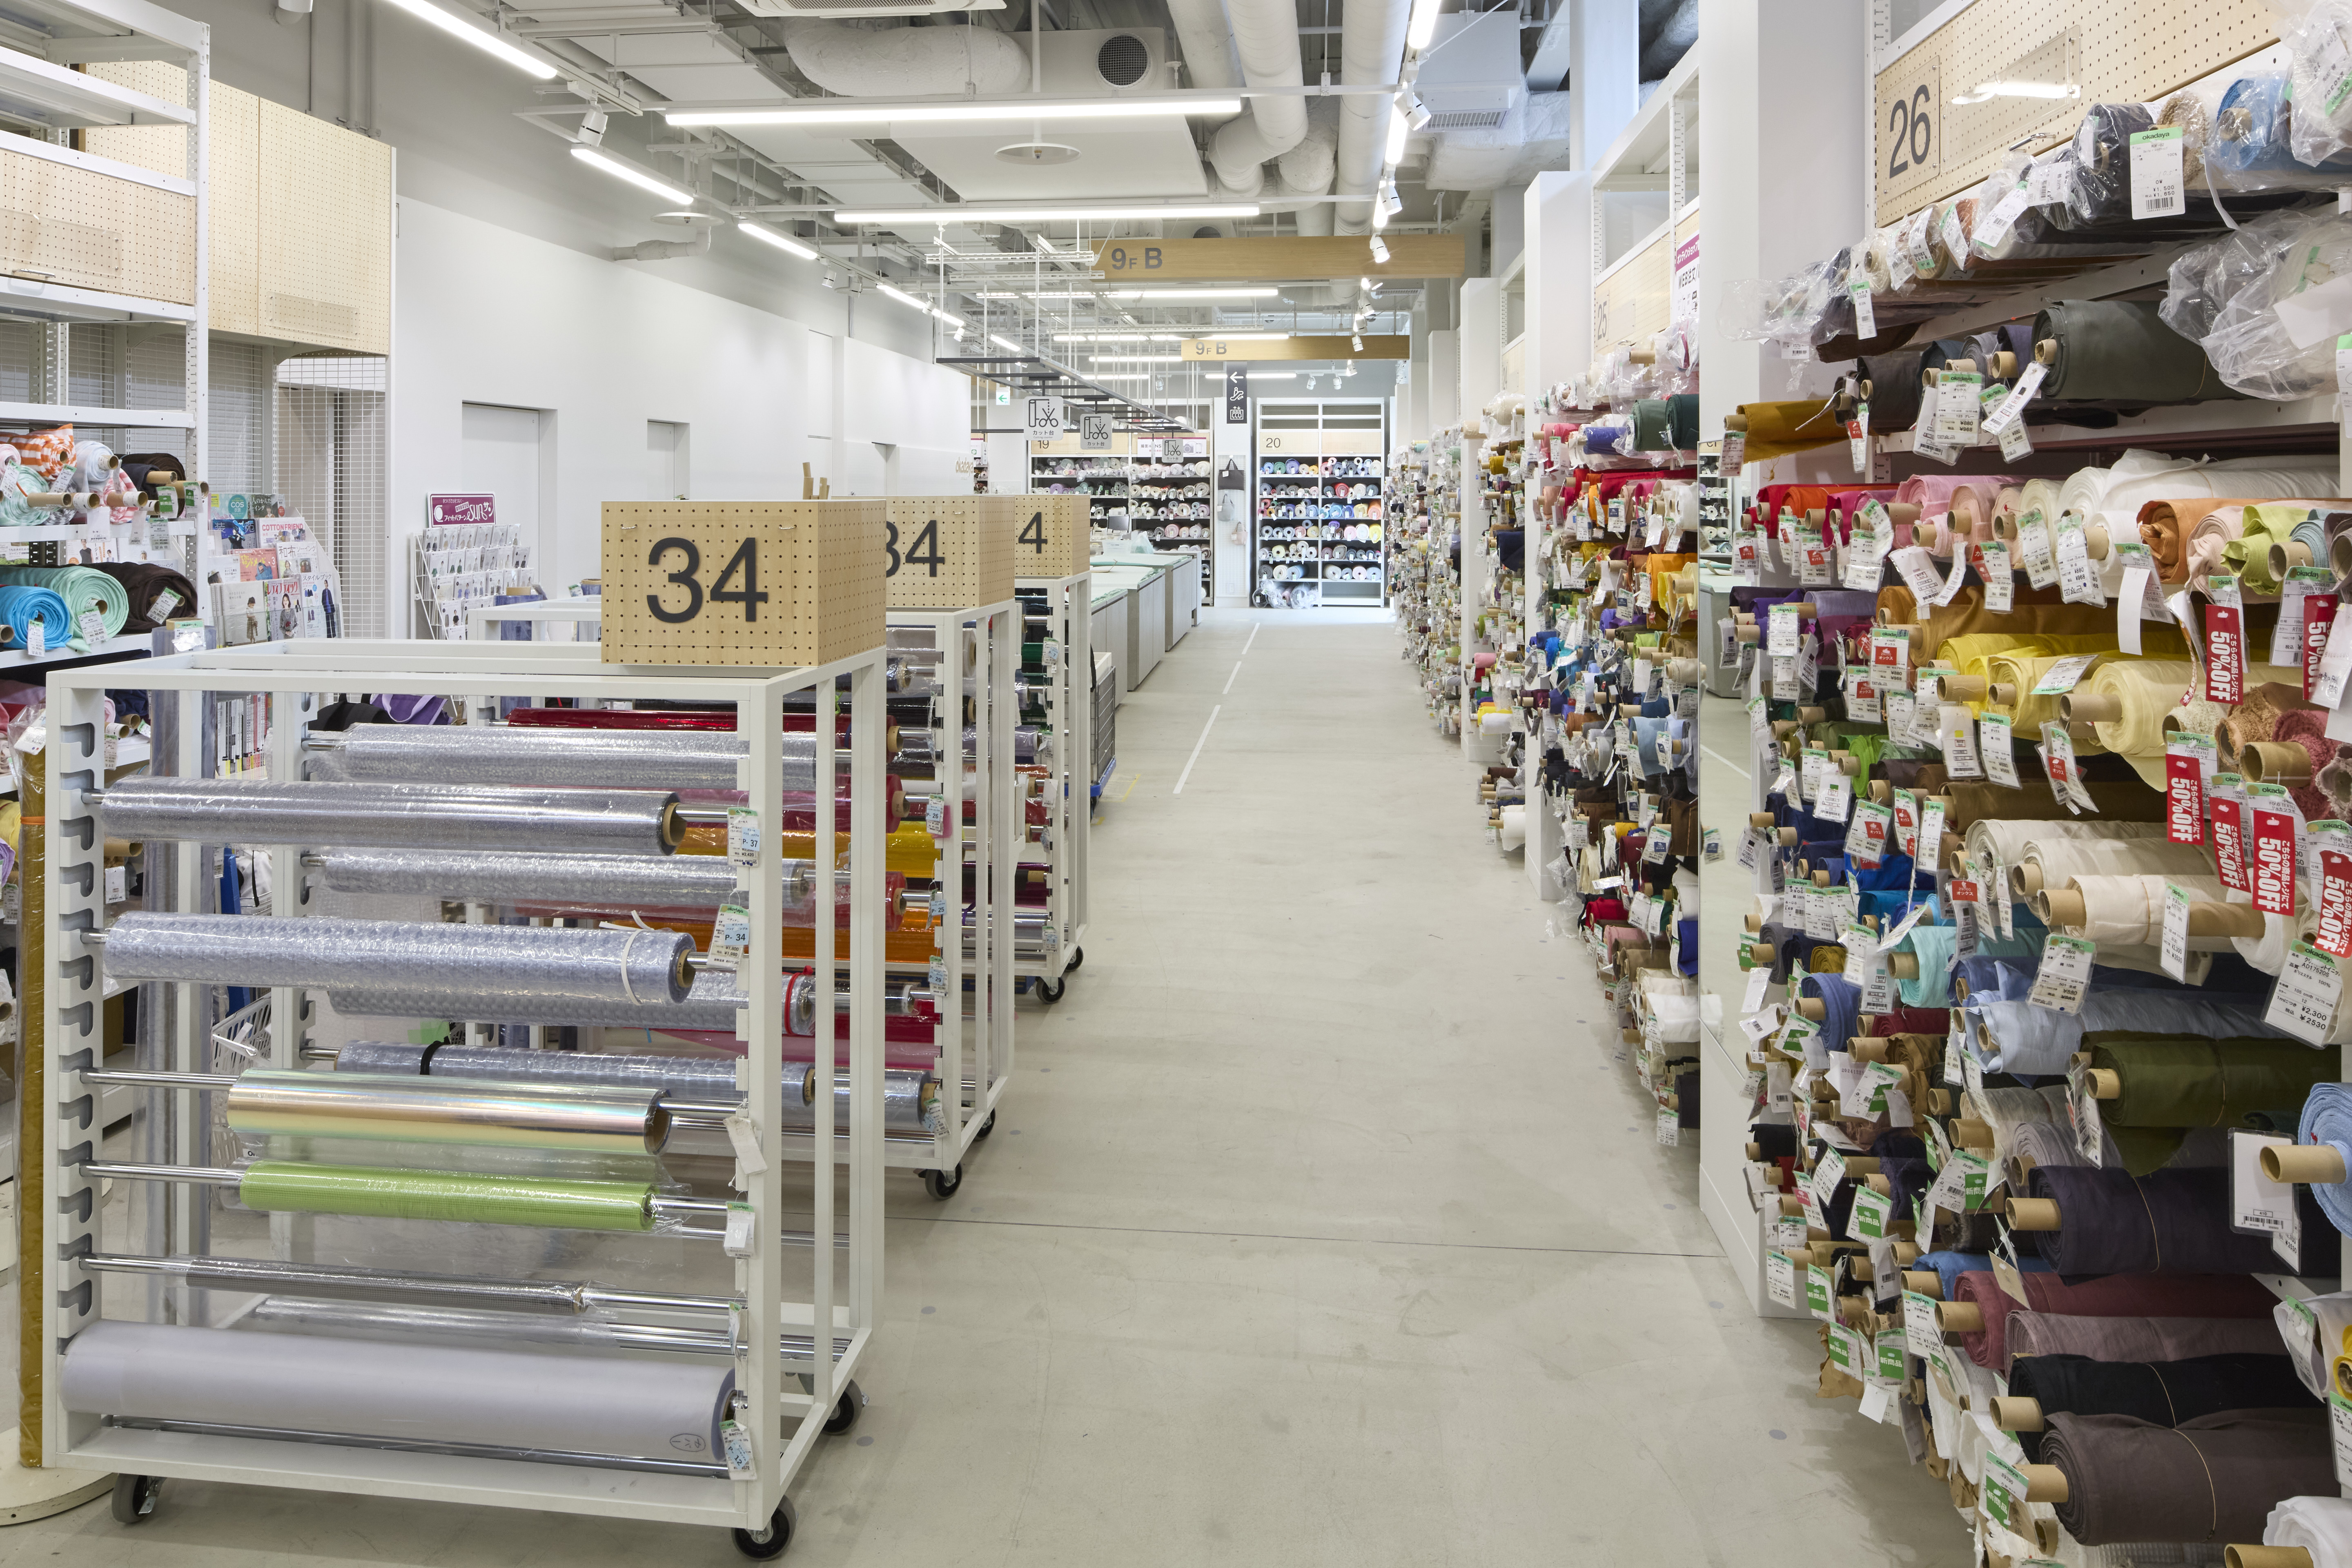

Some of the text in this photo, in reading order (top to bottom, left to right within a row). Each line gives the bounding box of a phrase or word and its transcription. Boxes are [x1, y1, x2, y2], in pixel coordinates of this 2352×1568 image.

[1889, 85, 1931, 178] 26
[1111, 247, 1163, 270] 9F B
[1679, 264, 1699, 289] WEB注文/
[1597, 301, 1607, 340] 25
[1196, 341, 1226, 355] 9F B
[1038, 440, 1049, 449] 19
[1265, 438, 1280, 448] 20
[956, 457, 973, 477] okadaya
[279, 546, 296, 558] 和布
[647, 537, 768, 623] 34
[2211, 631, 2231, 701] 50%OFF
[1867, 805, 1884, 813] okadaya
[2172, 778, 2199, 842] こちらの商品レジにて 50%OFF
[2215, 822, 2245, 888] こちらの商品レジにて 50%OFF
[2258, 837, 2290, 911] こちらの商品レジにて 50%OFF
[2317, 875, 2345, 953] 50%OFF
[2302, 963, 2330, 977] AD17520S
[2294, 969, 2331, 988] ポリエステル 100%
[2277, 996, 2297, 1007] 1mにつき
[1877, 1066, 1894, 1075] okadaya
[1962, 1155, 1981, 1164] okadaya
[1866, 1191, 1883, 1201] okadaya
[1966, 1187, 1986, 1195] 新商品
[1858, 1216, 1880, 1226] 新商品
[1773, 1254, 1786, 1262] okadaya
[1808, 1292, 1826, 1301] 新商品
[1911, 1295, 1929, 1304] okadaya
[1924, 1339, 1939, 1347] ¥1,100
[1830, 1344, 1848, 1357] 新商品
[1880, 1357, 1902, 1368] 新商品
[734, 1455, 742, 1466] 12
[1996, 1460, 2018, 1478] okadaya
[2002, 1473, 2013, 1484] 89390
[1987, 1490, 2007, 1515] 新商品
